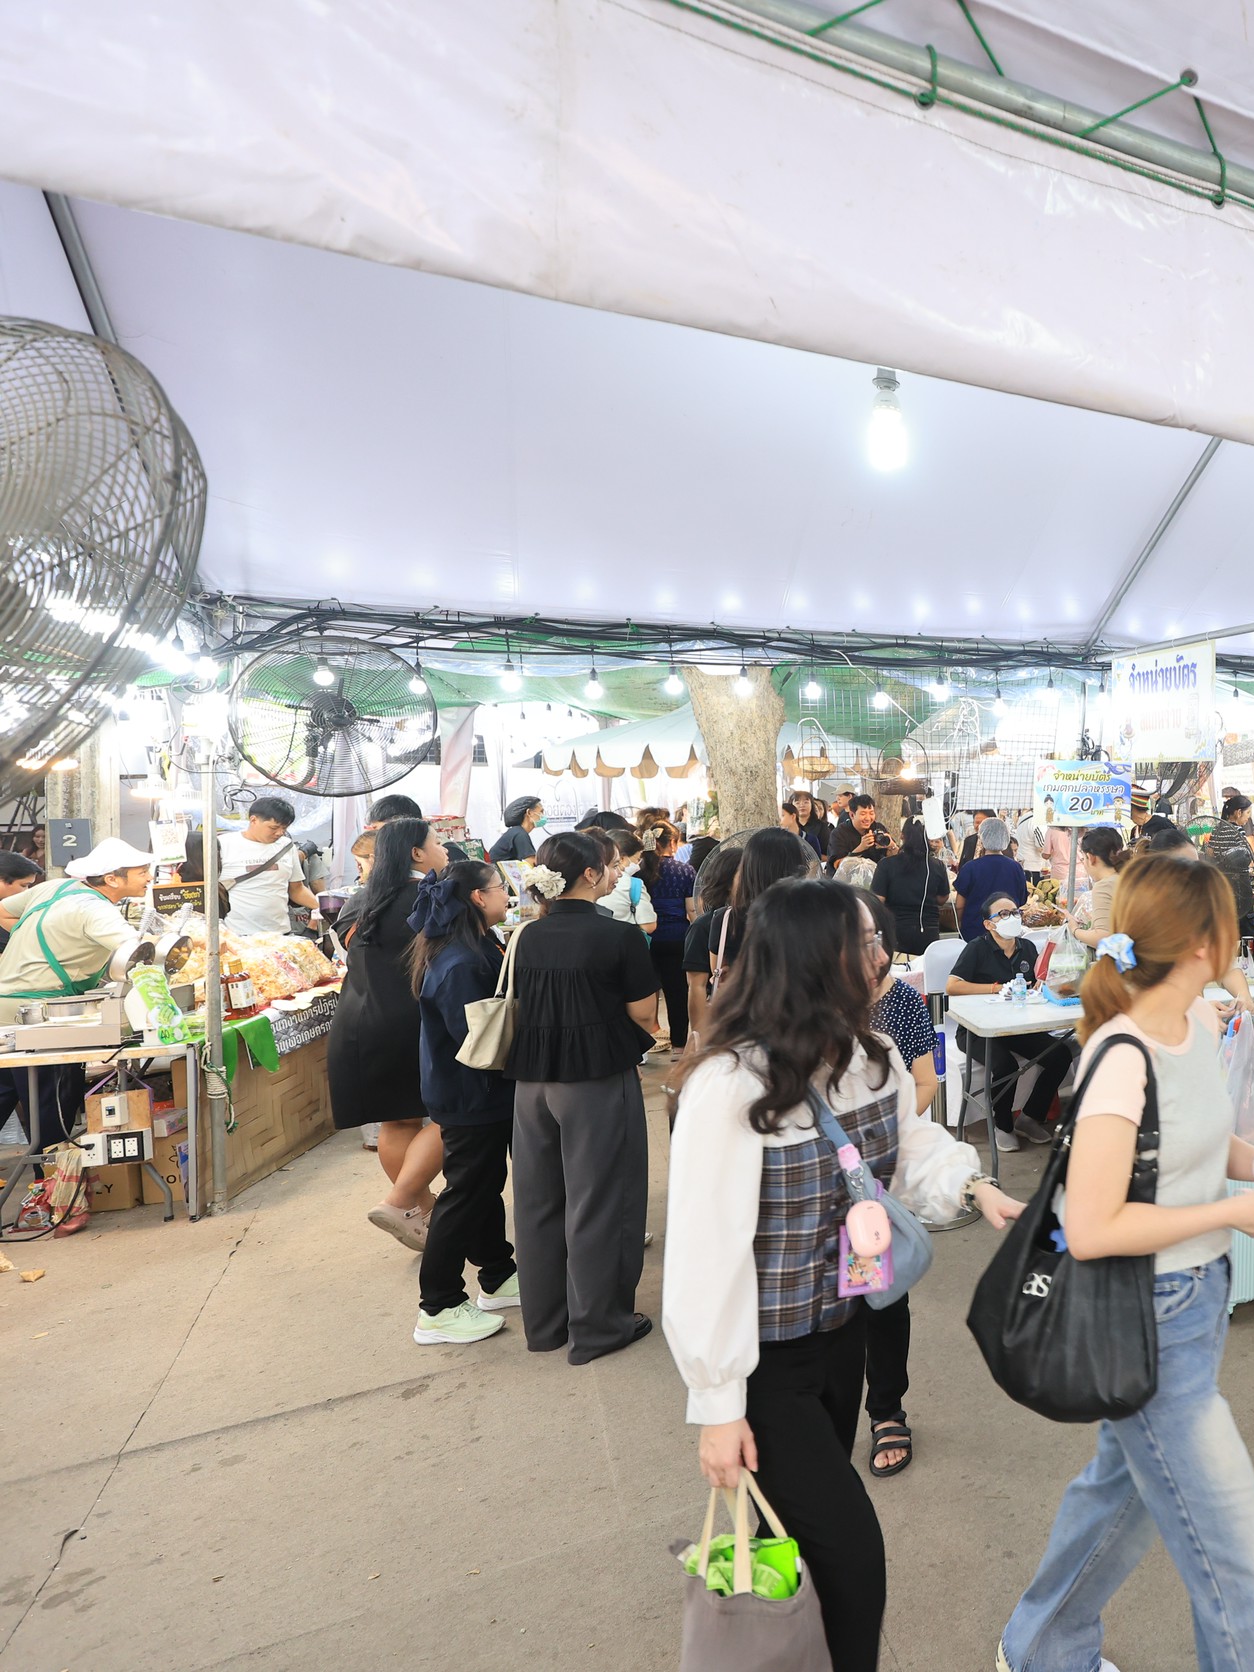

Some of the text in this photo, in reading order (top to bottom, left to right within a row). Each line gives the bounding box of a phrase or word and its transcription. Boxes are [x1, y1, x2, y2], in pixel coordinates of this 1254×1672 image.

[1128, 654, 1198, 694] จำหน่ายบัตร
[1053, 770, 1112, 782] จำหน่ายบัตร
[1043, 783, 1125, 794] เกมตกปลาหรรษา
[1069, 797, 1093, 812] 20
[62, 834, 78, 847] 2
